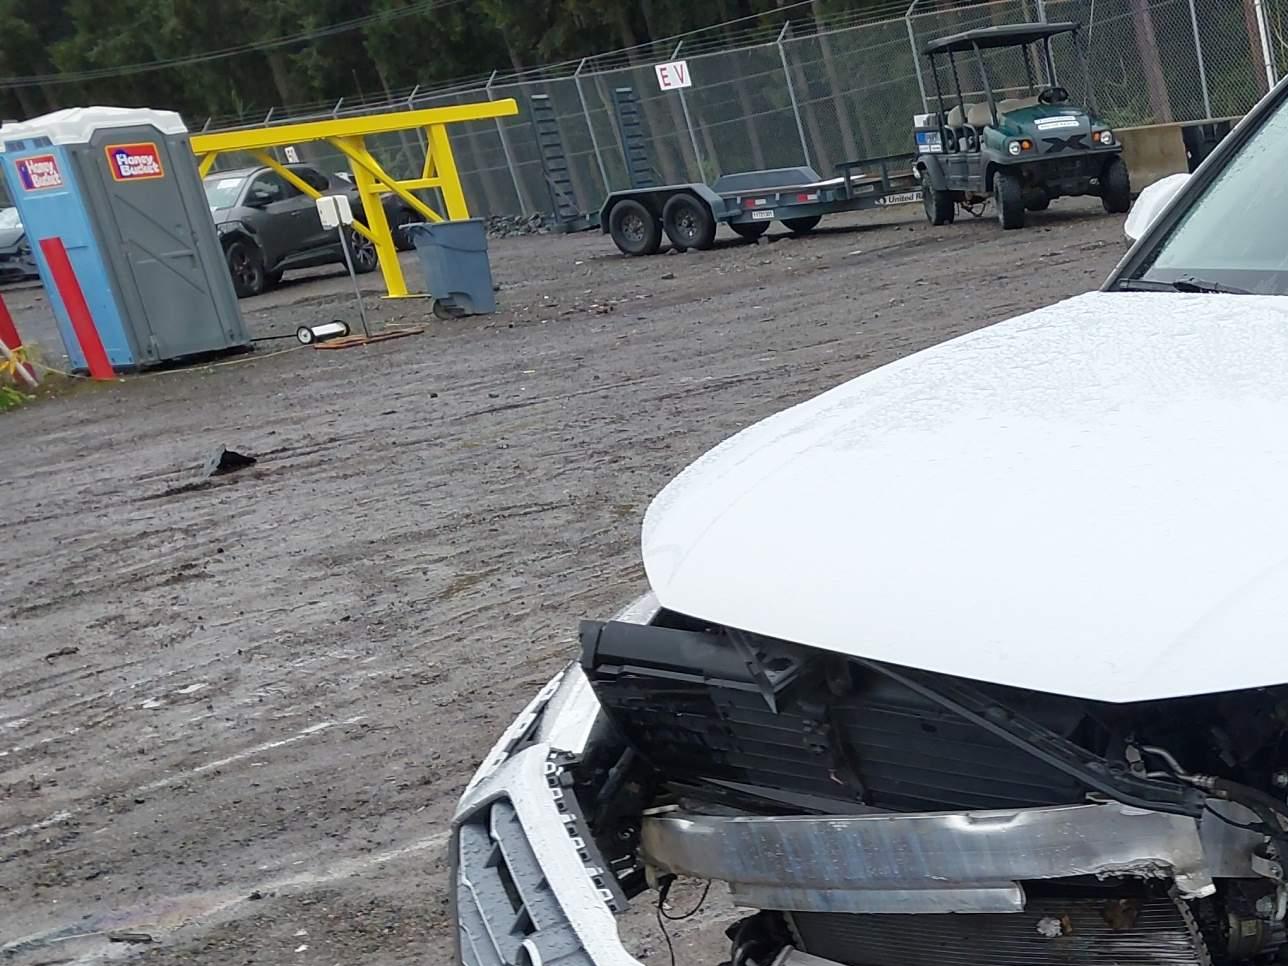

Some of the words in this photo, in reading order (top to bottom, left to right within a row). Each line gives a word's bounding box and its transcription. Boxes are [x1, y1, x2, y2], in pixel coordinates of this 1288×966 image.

[660, 64, 684, 87] EV
[24, 159, 54, 175] Honey
[115, 153, 153, 166] Honey
[119, 161, 160, 176] Bucket
[31, 169, 62, 188] Bucket
[888, 192, 914, 204] United
